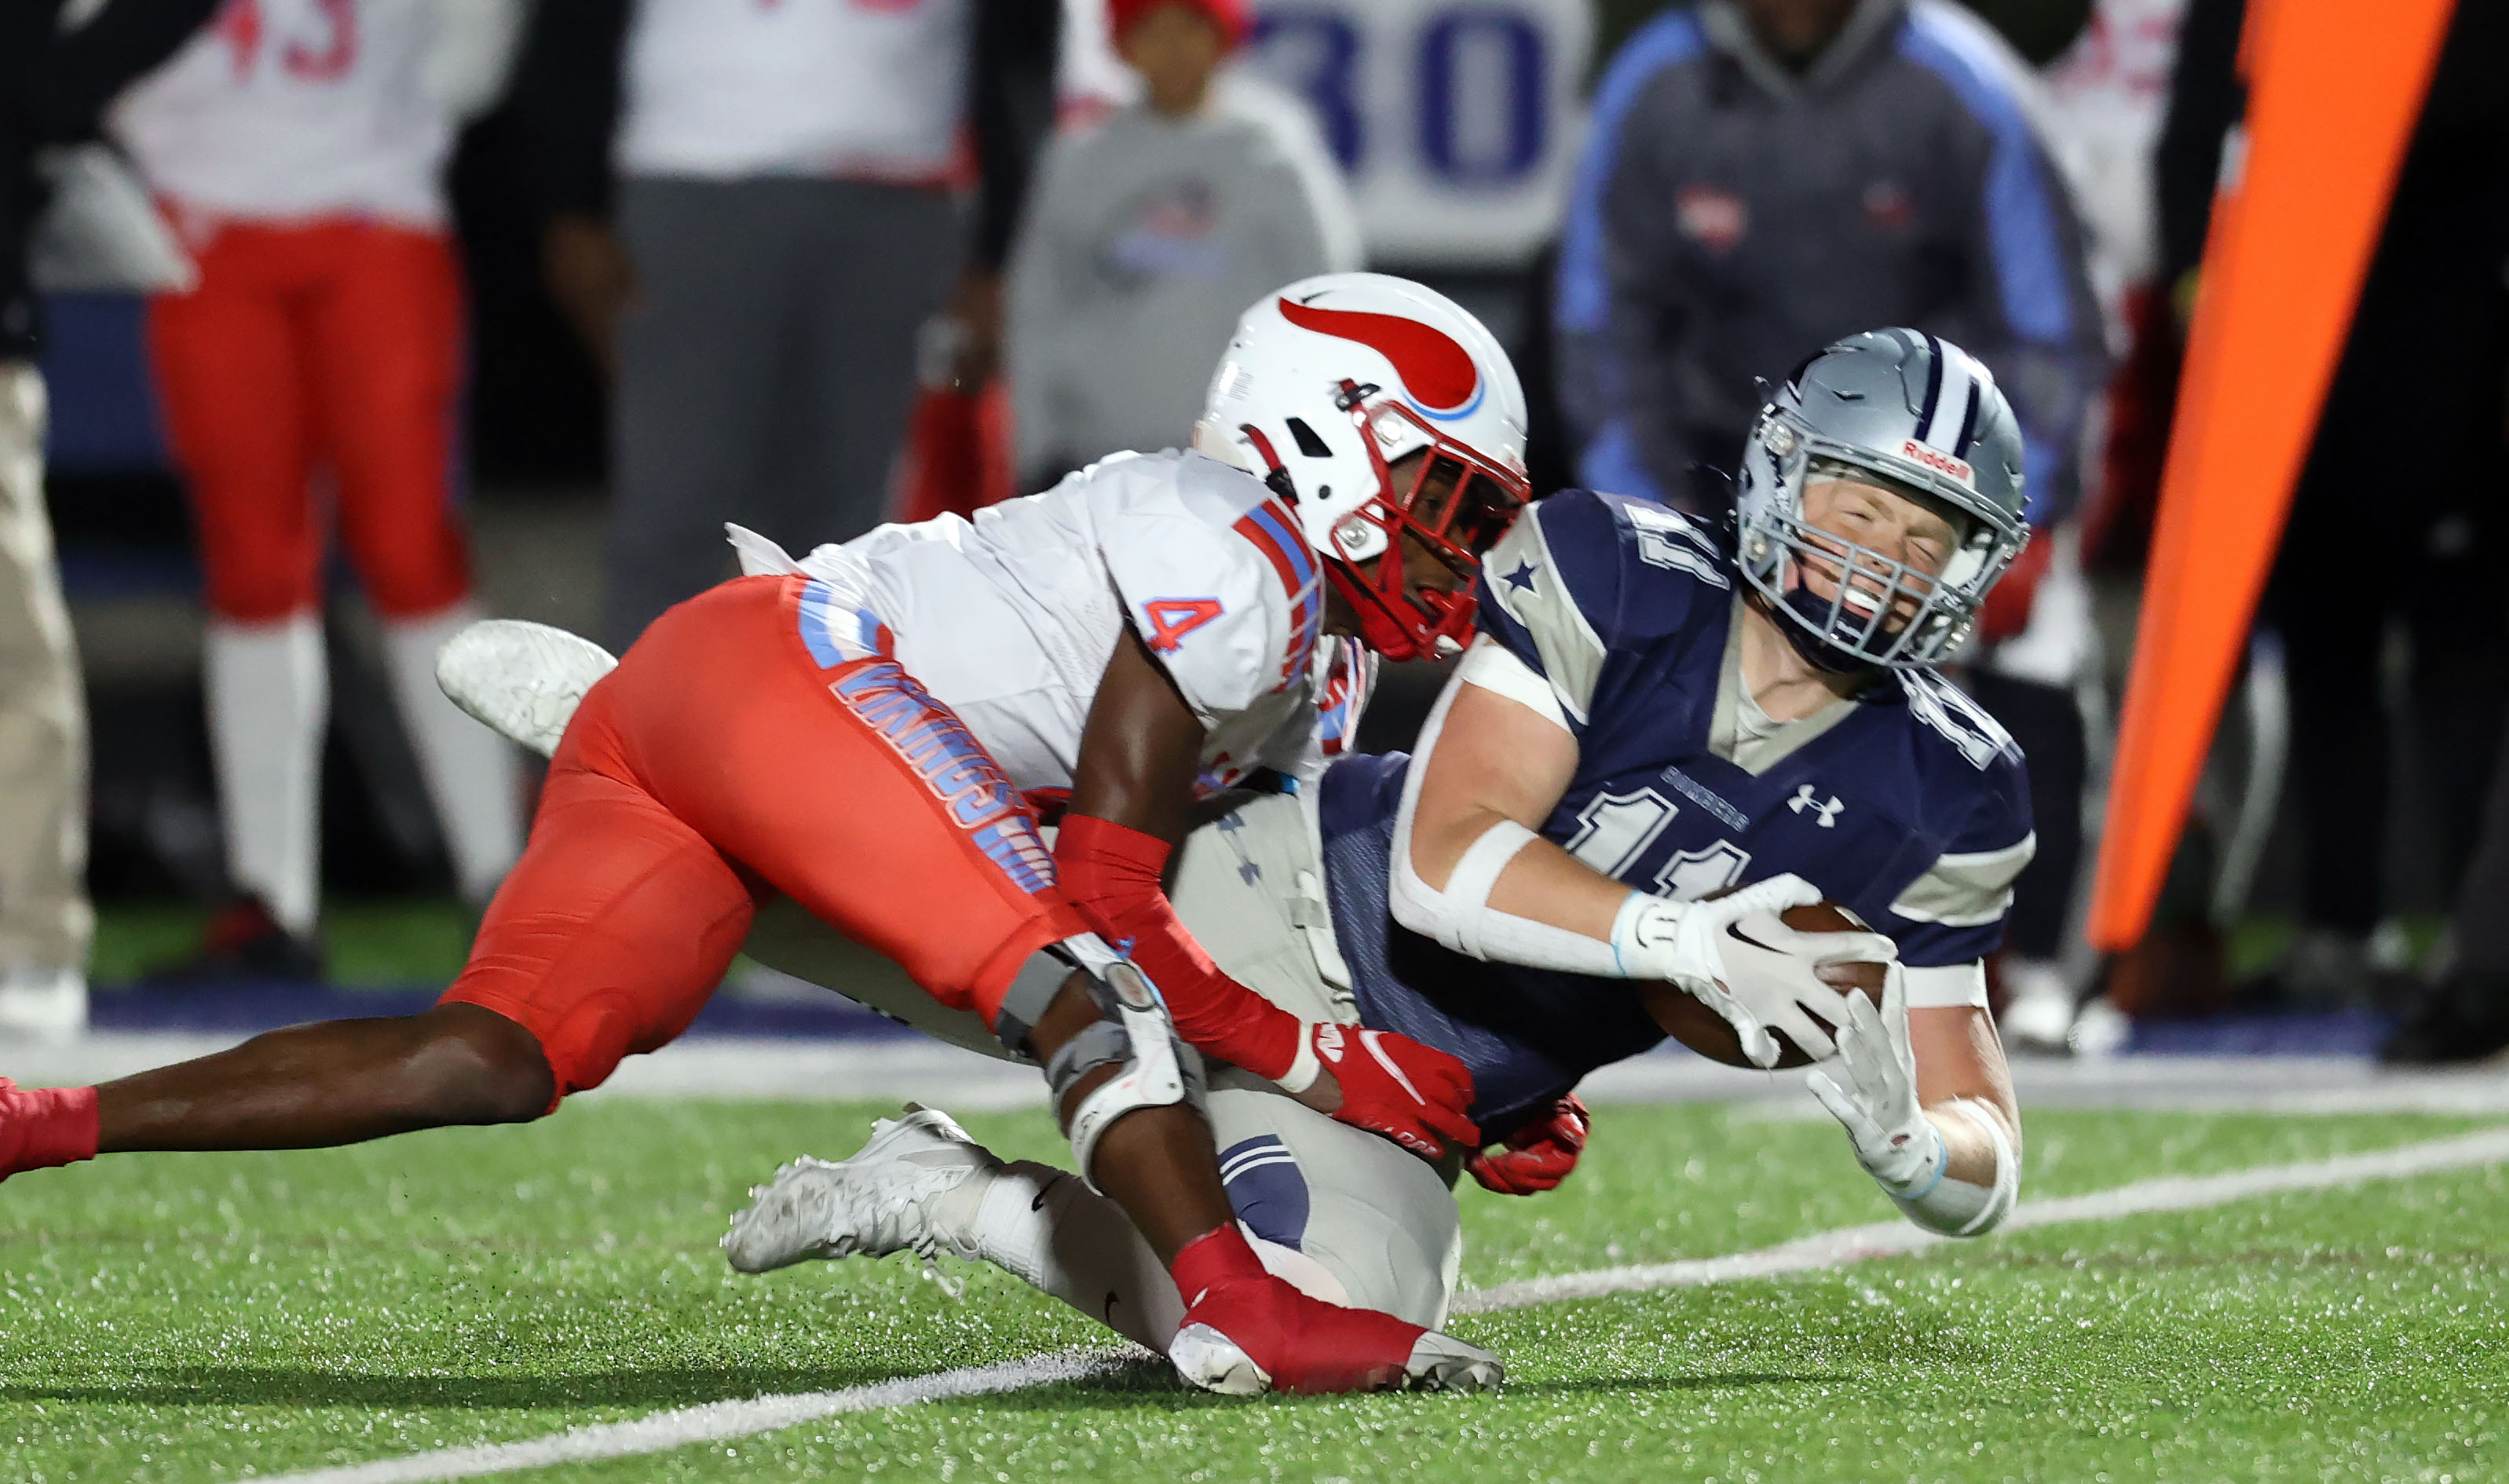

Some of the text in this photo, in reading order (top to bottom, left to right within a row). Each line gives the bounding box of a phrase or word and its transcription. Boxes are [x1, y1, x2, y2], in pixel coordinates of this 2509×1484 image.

[1247, 9, 1549, 190] 30
[1140, 596, 1226, 656] 4
[828, 661, 1026, 829] VIKINGS
